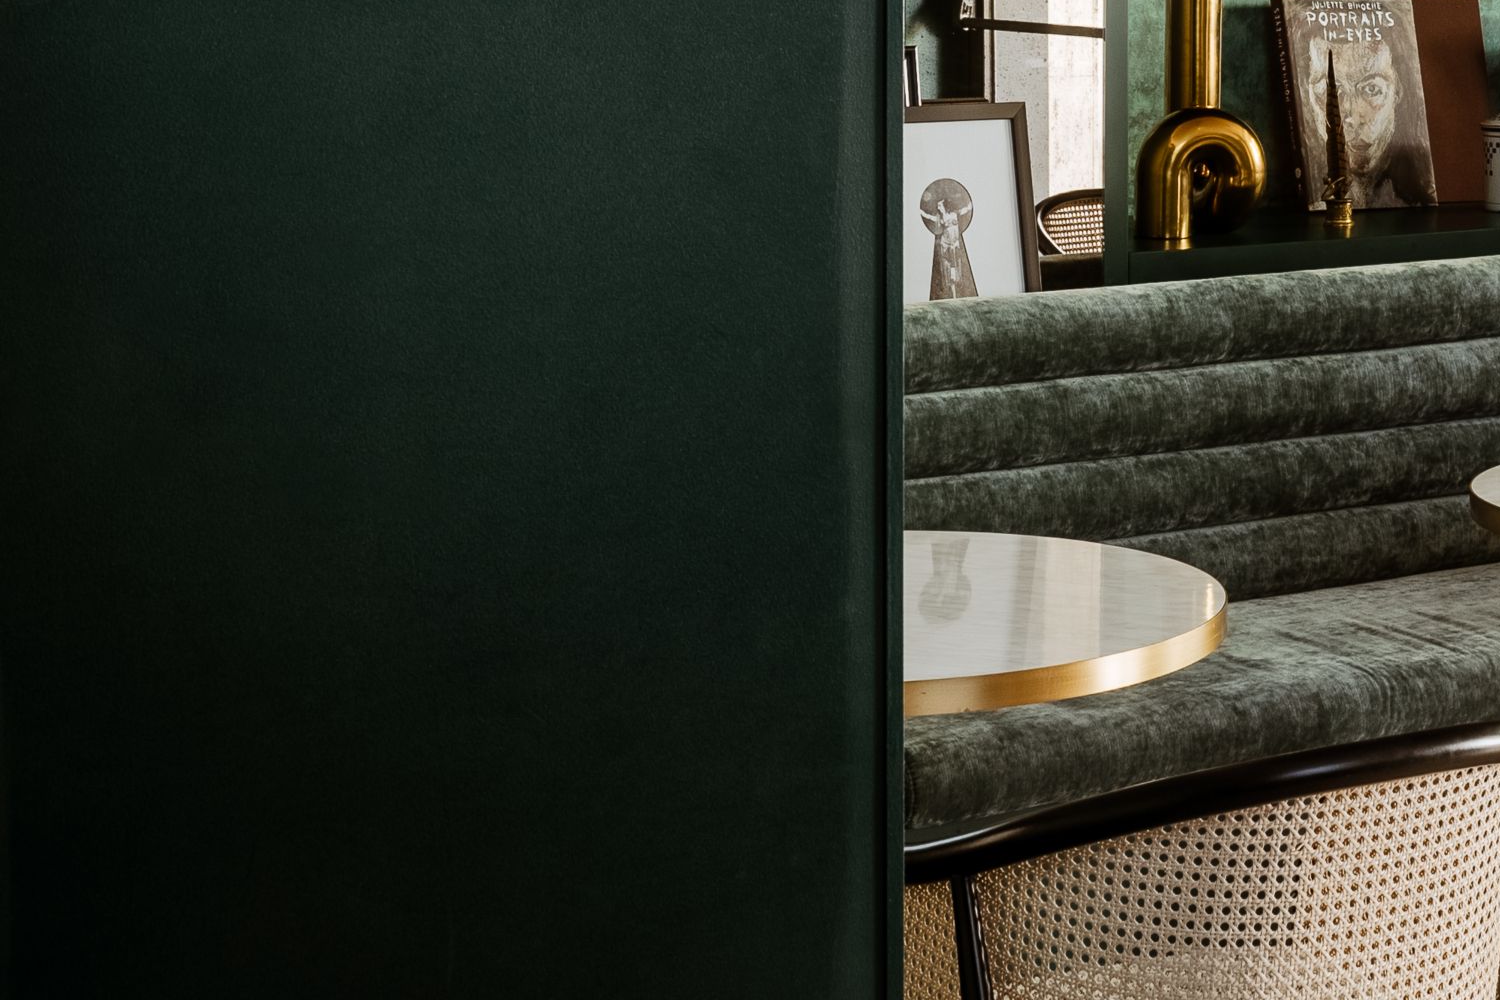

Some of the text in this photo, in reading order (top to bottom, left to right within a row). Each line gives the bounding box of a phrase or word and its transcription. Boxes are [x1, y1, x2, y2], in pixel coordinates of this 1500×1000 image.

[1311, 1, 1381, 11] JULIETTE BINOCHE
[1306, 11, 1394, 28] PORTRAITS
[1323, 27, 1382, 43] IN-EYES
